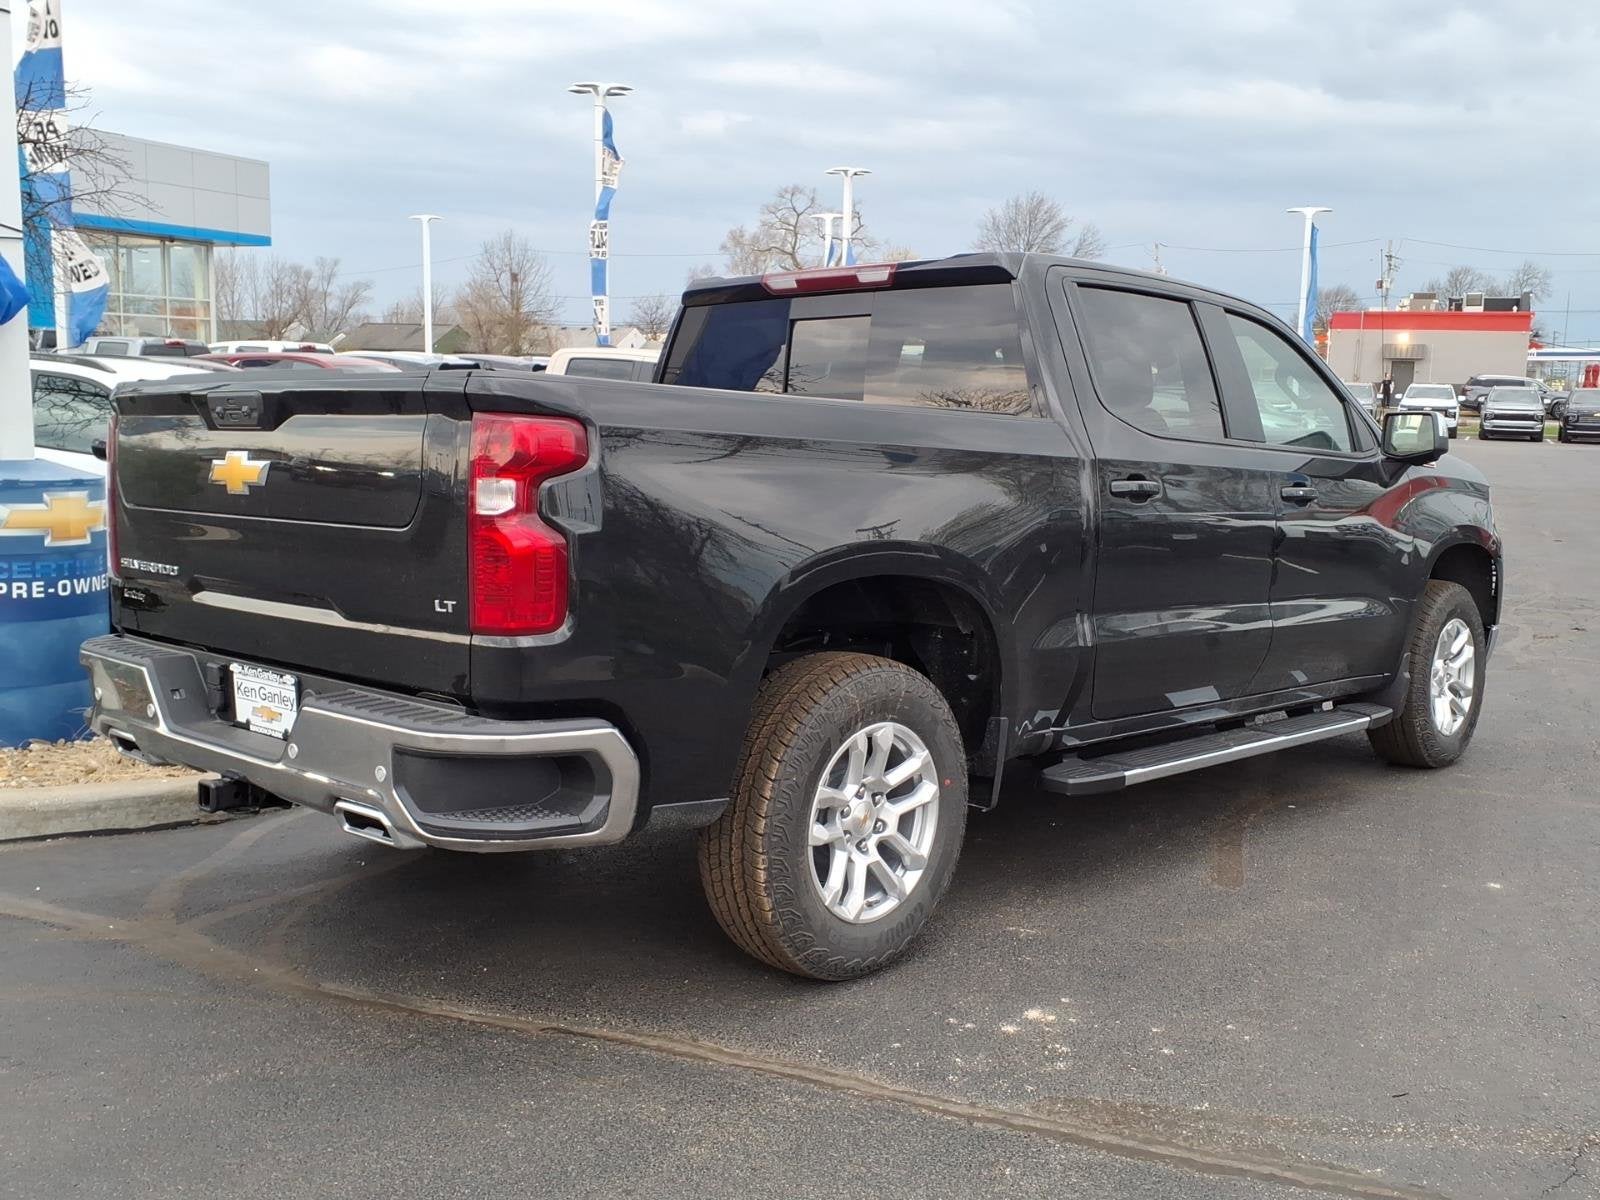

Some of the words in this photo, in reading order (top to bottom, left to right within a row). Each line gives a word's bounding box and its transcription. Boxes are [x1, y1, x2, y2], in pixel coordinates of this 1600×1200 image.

[120, 557, 179, 576] SILVERADO
[434, 599, 456, 613] LT
[236, 681, 257, 699] Ken
[258, 686, 295, 712] Ganley
